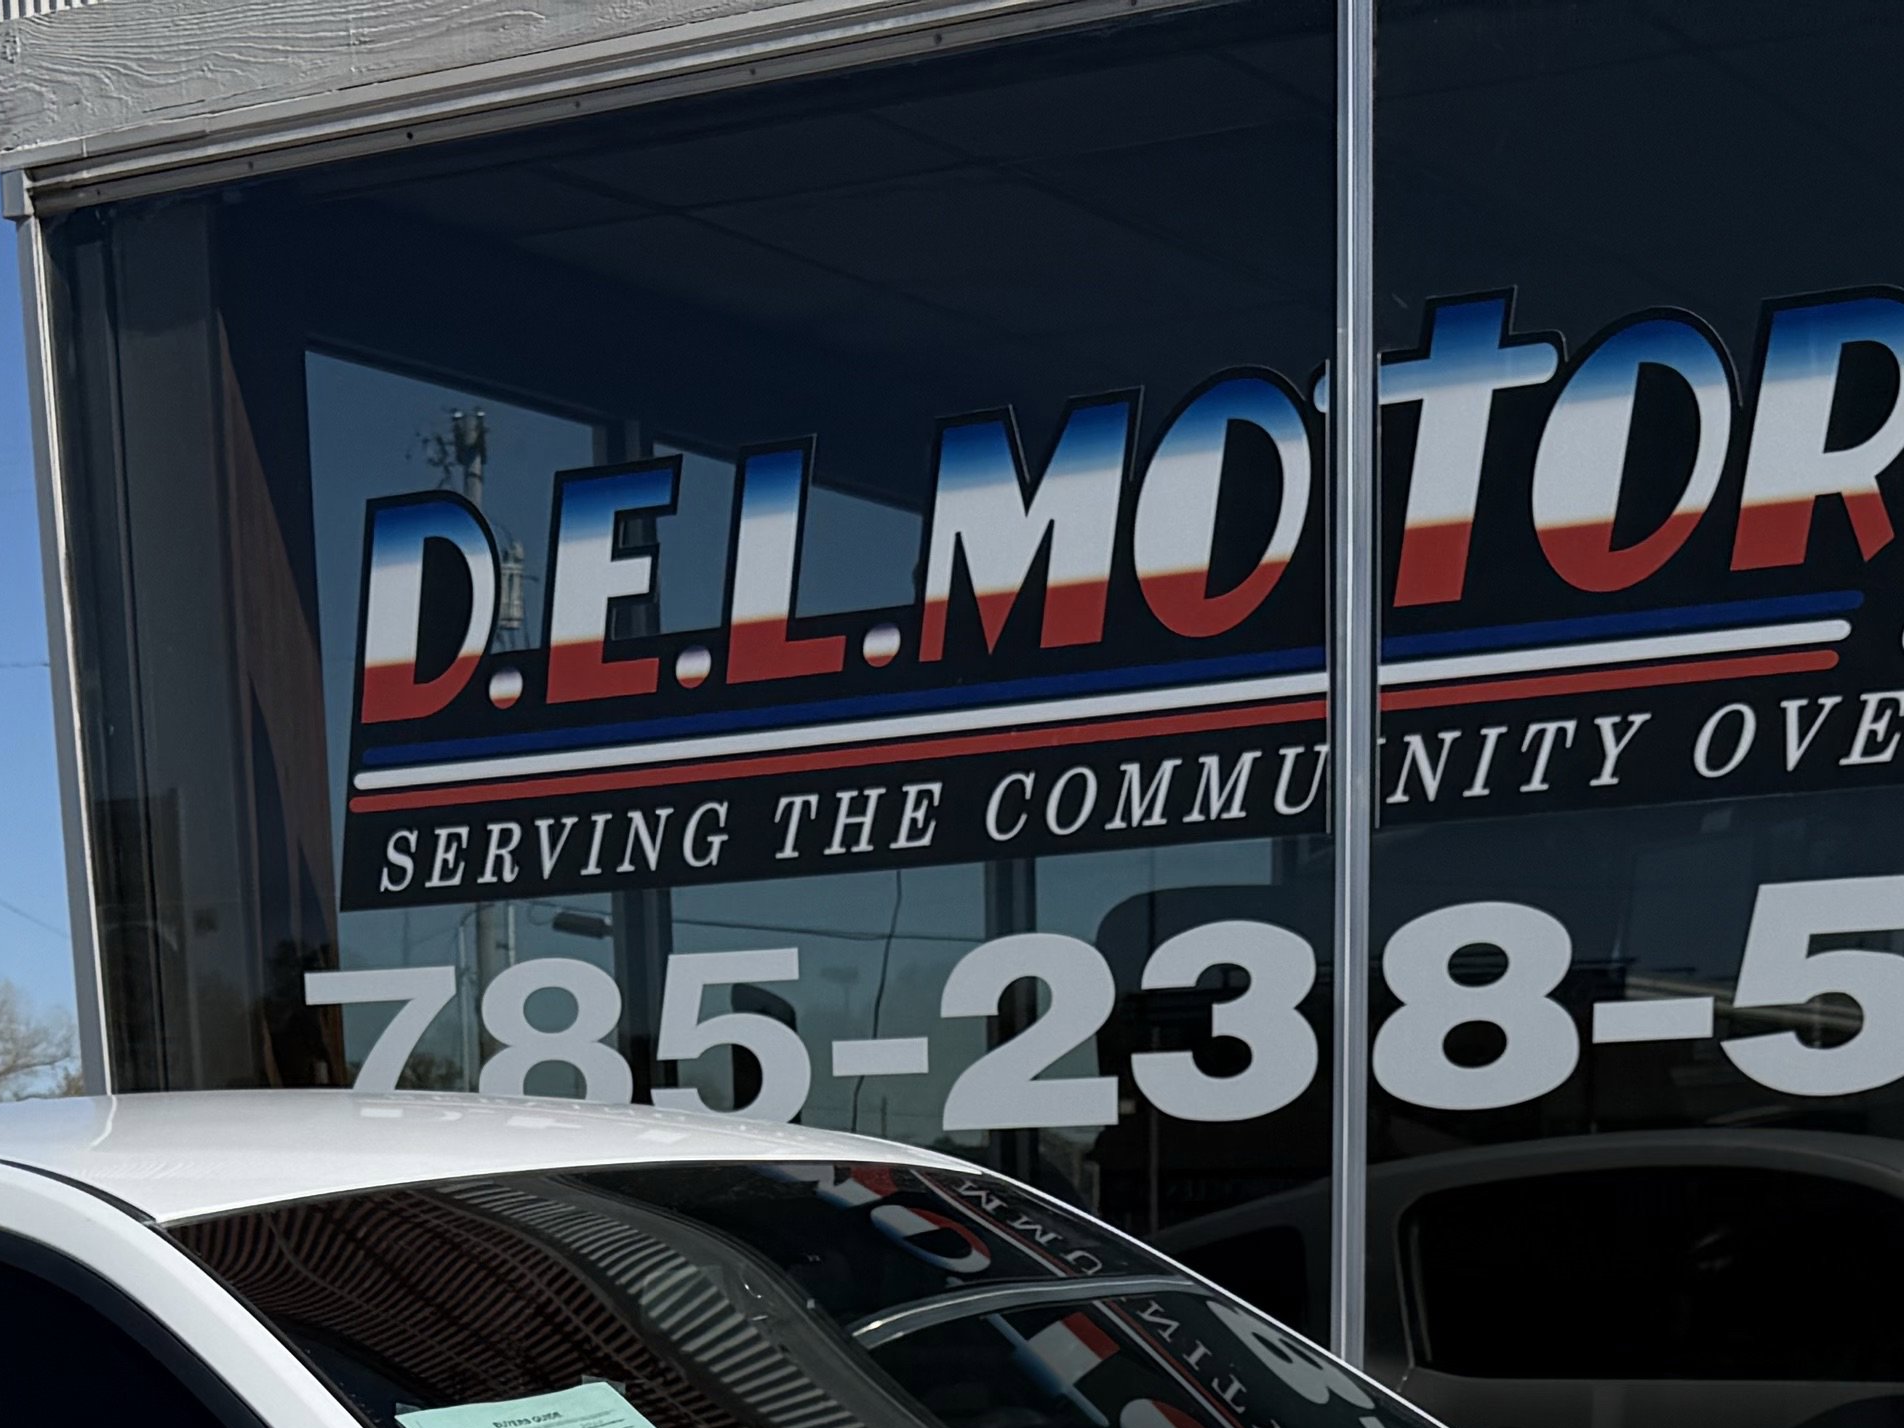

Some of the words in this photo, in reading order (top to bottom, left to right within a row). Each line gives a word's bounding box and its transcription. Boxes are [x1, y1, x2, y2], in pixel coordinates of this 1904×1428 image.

[379, 801, 730, 894] SERVING
[773, 782, 944, 861] THE
[986, 713, 1651, 841] COMMUNITY
